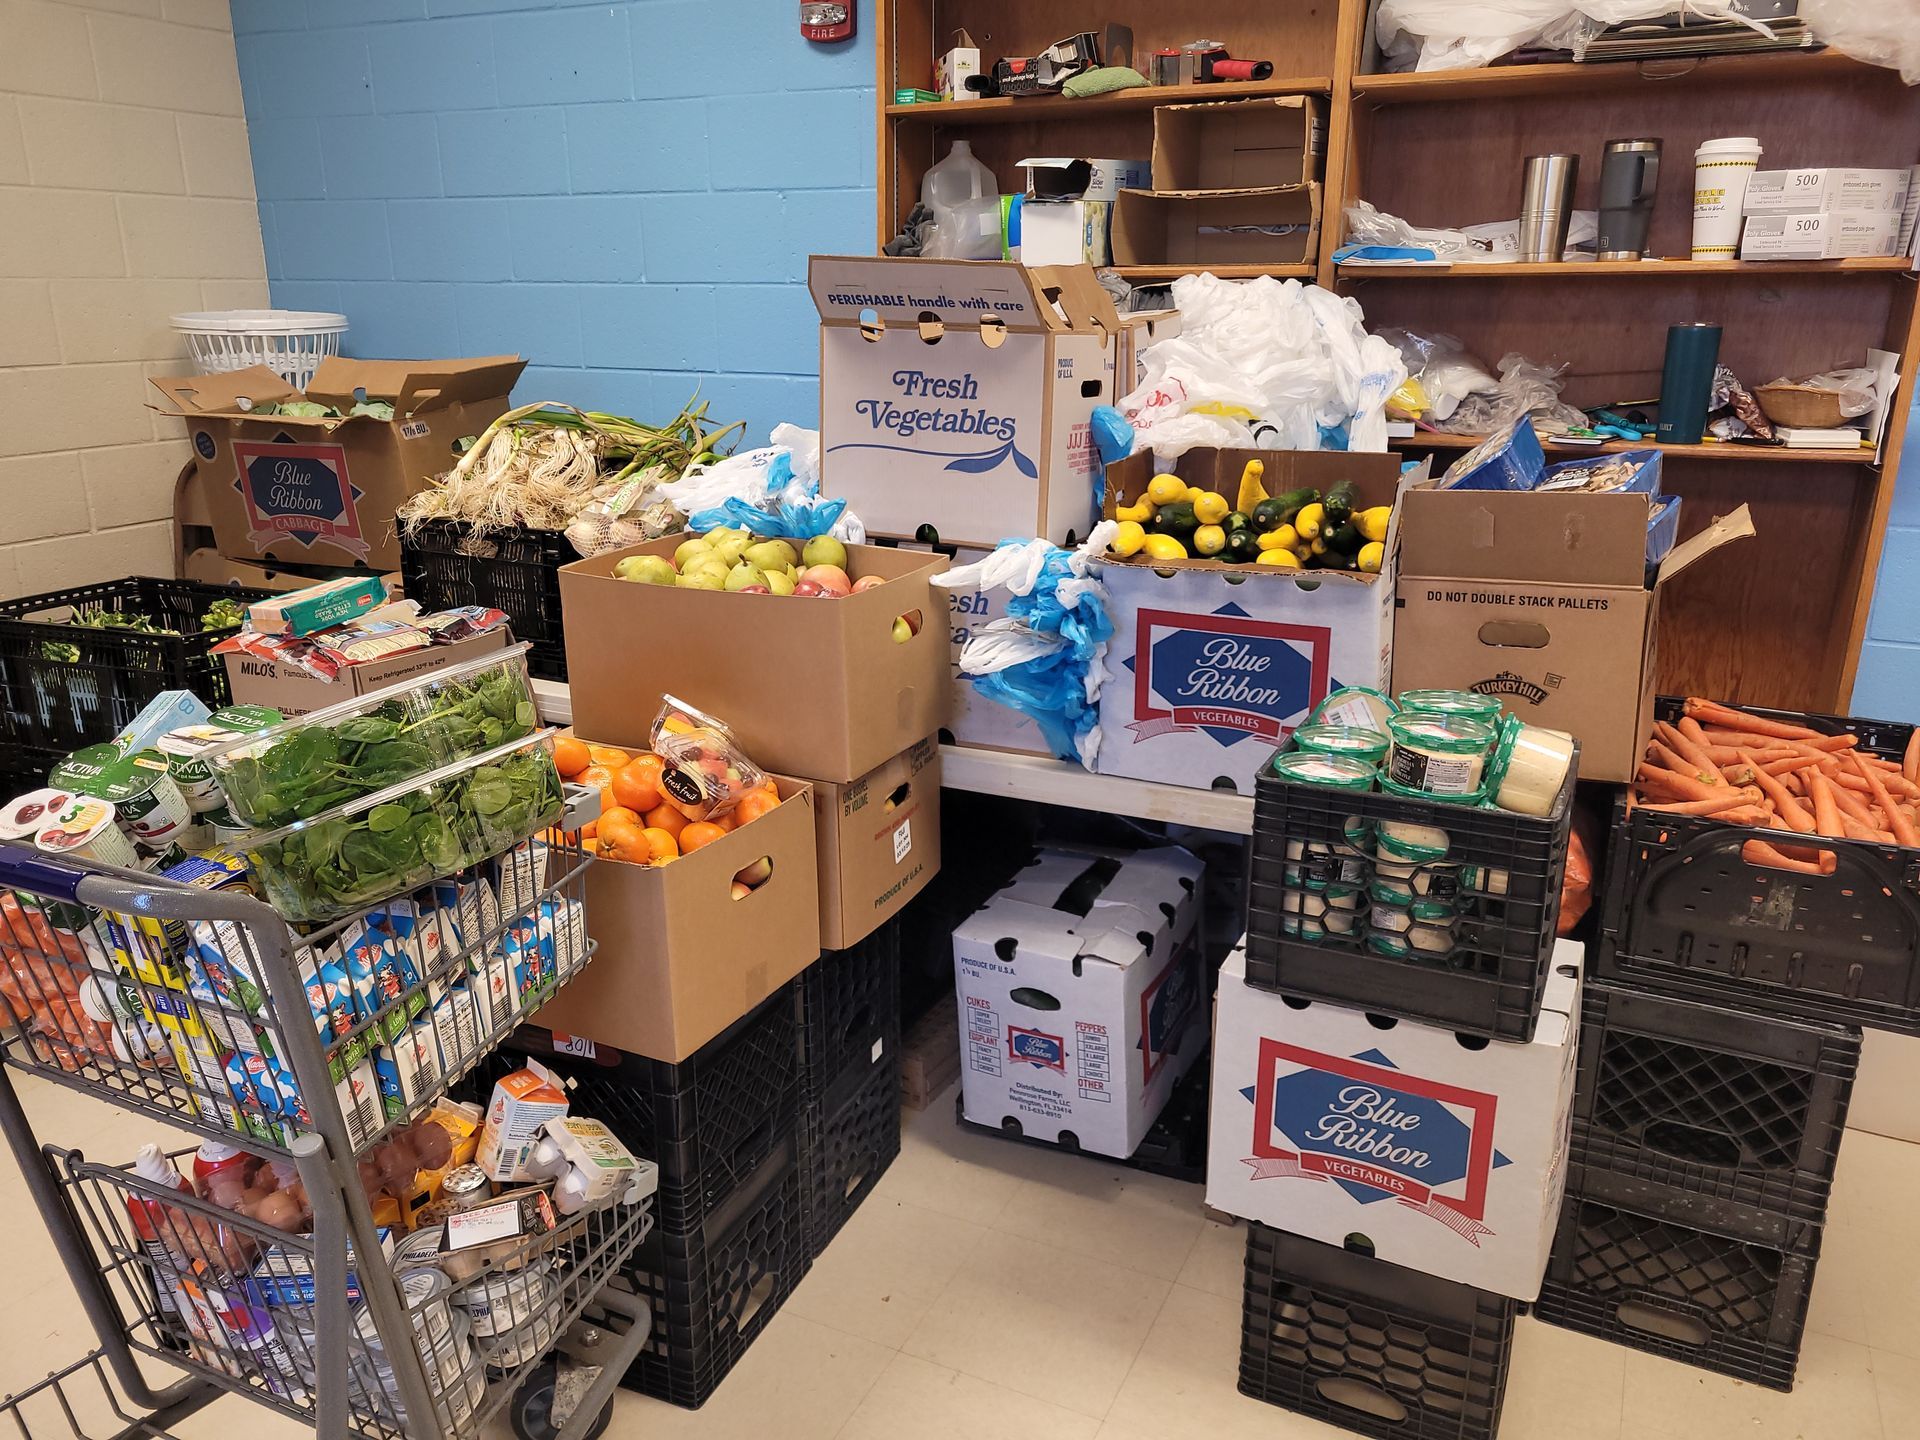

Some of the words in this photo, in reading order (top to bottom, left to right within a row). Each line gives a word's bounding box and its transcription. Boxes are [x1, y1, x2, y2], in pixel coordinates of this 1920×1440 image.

[811, 29, 835, 38] FIRE
[1011, 75, 1026, 83] garbage
[1025, 73, 1035, 81] bags
[1796, 174, 1819, 187] 500
[1796, 219, 1820, 232] 500
[828, 294, 905, 307] PERISHABLE
[907, 295, 955, 308] handle
[958, 298, 990, 309] with
[994, 302, 1024, 312] care
[1057, 358, 1073, 368] PRODUCE
[1057, 370, 1063, 378] OF
[892, 370, 979, 400] Fresh
[416, 423, 429, 434] BU.
[855, 400, 1016, 442] Vegetables
[1067, 432, 1081, 449] JJJ
[273, 460, 312, 486] Blue
[268, 484, 323, 511] Ribbon
[275, 518, 327, 532] CABBAGE
[949, 591, 988, 615] esh
[1427, 591, 1442, 602] DO
[1445, 592, 1467, 602] NOT
[1471, 593, 1516, 605] DOUBLE
[1518, 596, 1554, 608] STACK
[1558, 599, 1609, 610] PALLETS
[314, 608, 333, 618] SHARP
[333, 602, 352, 615] EXTRA
[335, 609, 348, 619] NEW
[321, 613, 335, 622] YORK
[1195, 638, 1271, 673] Blue
[283, 668, 308, 679] Famous
[369, 673, 383, 683] Keep
[384, 666, 416, 679] Refrigerated
[1177, 668, 1280, 705] Ribbon
[1473, 680, 1519, 694] TURKEY
[1517, 682, 1545, 702] HILL
[278, 706, 295, 715] PULL
[217, 711, 268, 728] ACTIVIA
[1192, 711, 1260, 729] VEGETABLES
[61, 761, 105, 776] ACTIVIA
[170, 760, 208, 777] CTIVIA
[180, 785, 193, 793] ERO
[681, 783, 697, 801] fruit
[842, 788, 853, 804] ONE
[844, 805, 852, 818] BY
[852, 793, 869, 814] VOLUME
[874, 882, 902, 910] PRODUCE
[902, 874, 911, 887] OF
[910, 863, 924, 880] U.S.A.
[961, 957, 988, 969] PRODUCE
[988, 963, 997, 971] OF
[998, 965, 1017, 976] U.S.A.
[972, 970, 982, 978] BU.
[123, 985, 143, 1012] ACTI
[966, 996, 991, 1010] CUKES
[976, 1017, 991, 1025] SELECT
[1075, 1021, 1107, 1034] PEPPERS
[969, 1031, 998, 1046] EGGPLANT
[1027, 1037, 1049, 1048] Blue
[980, 1055, 992, 1063] LARGE
[1022, 1046, 1052, 1059] Ribbon
[980, 1063, 994, 1072] CHOICE
[1086, 1070, 1103, 1078] CHOICE
[1016, 1082, 1052, 1096] Distributed
[1053, 1091, 1063, 1099] By:
[1077, 1078, 1104, 1090] OTHER
[1009, 1088, 1038, 1100] Pennrose
[1038, 1095, 1058, 1105] Farms,
[1059, 1099, 1071, 1107] LLC
[1009, 1095, 1043, 1108] Wellington,
[1051, 1105, 1072, 1114] 33414
[1328, 1085, 1421, 1131] Blue
[1304, 1114, 1432, 1169] Ribbon
[1323, 1160, 1406, 1192] VEGETABLES
[401, 1250, 438, 1261] PHILADELP
